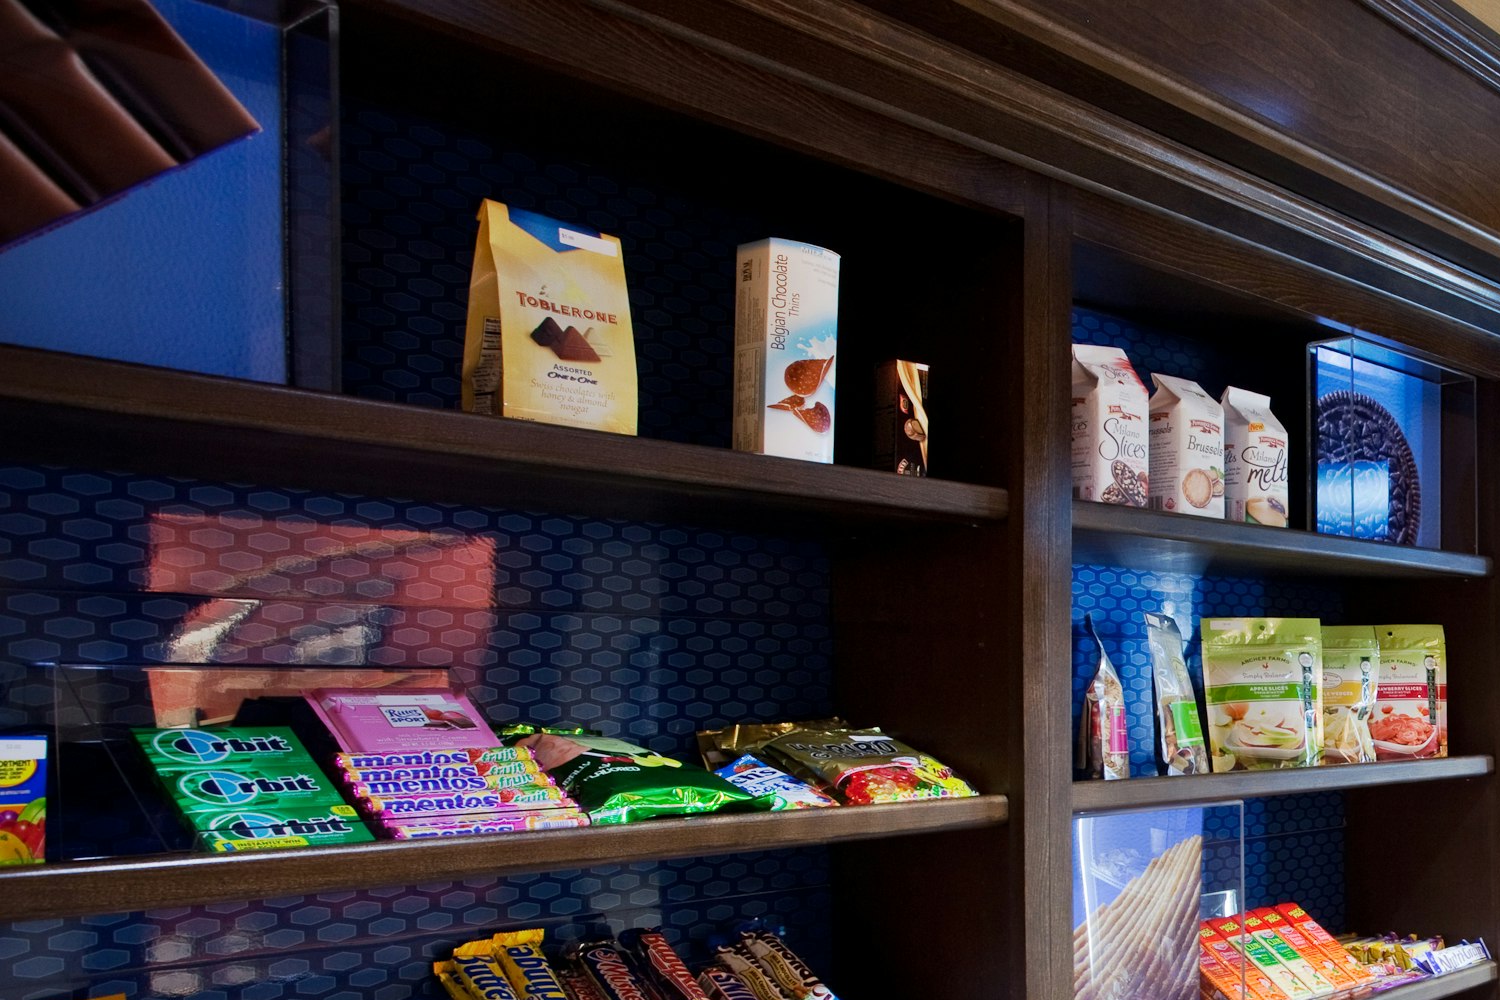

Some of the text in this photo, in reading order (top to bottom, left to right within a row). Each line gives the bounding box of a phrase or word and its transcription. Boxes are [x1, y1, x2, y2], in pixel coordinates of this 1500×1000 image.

[516, 291, 618, 325] TOBLERONE
[771, 254, 790, 351] Belgian Chocolate
[788, 293, 800, 318] Thins
[553, 363, 593, 376] ASSORTED
[554, 383, 596, 396] chocolates
[1112, 422, 1141, 440] Milano
[1250, 423, 1264, 431] New
[1099, 418, 1147, 461] Slices
[1187, 434, 1224, 457] Brussels
[1250, 448, 1277, 464] Milano
[1241, 655, 1291, 666] ARCHER FARMS
[385, 707, 421, 719] Ritter
[391, 715, 427, 724] SPORT
[160, 731, 293, 760] Orbit
[351, 748, 519, 769] mentos fruit
[358, 762, 527, 782] mentos fruit
[186, 772, 321, 804] Orbit
[366, 772, 536, 795] mentos fruit
[380, 790, 550, 813] mentos fruit
[217, 813, 354, 840] Orbit
